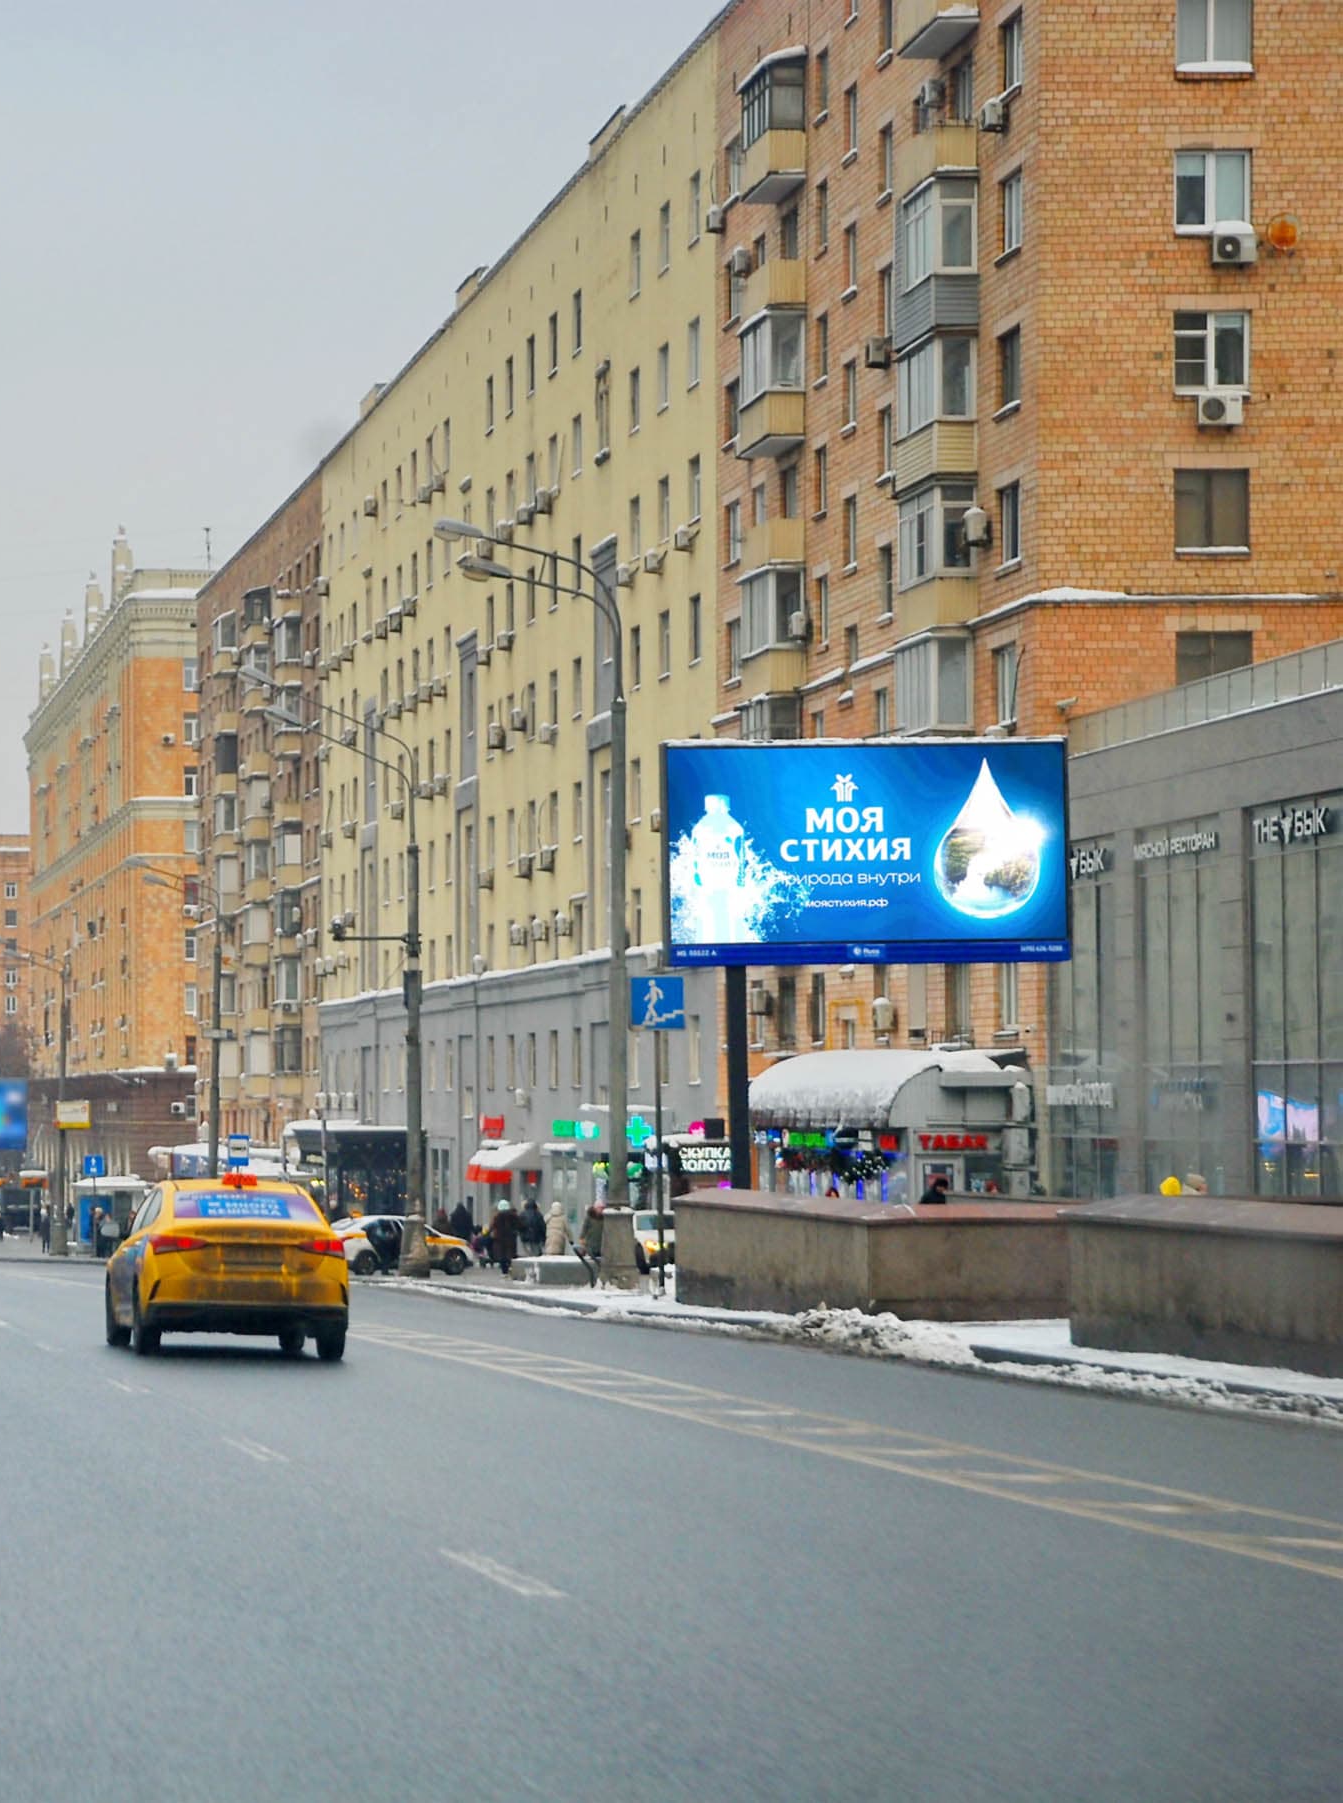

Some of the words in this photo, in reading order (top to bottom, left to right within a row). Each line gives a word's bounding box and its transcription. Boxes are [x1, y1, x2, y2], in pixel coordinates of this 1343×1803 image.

[805, 806, 884, 833] МОЯ
[1253, 816, 1279, 844] THE
[1294, 806, 1326, 837] БЫК
[780, 837, 912, 862] СТИХИЯ
[1170, 831, 1215, 855] РЕСТОРАН
[1079, 848, 1105, 874] БЫК
[777, 872, 853, 887] рирода
[857, 872, 921, 887] внутри
[805, 897, 889, 909] моястихия.рф
[679, 1146, 731, 1159] СКУПКА
[918, 1132, 990, 1151] ТАБАК
